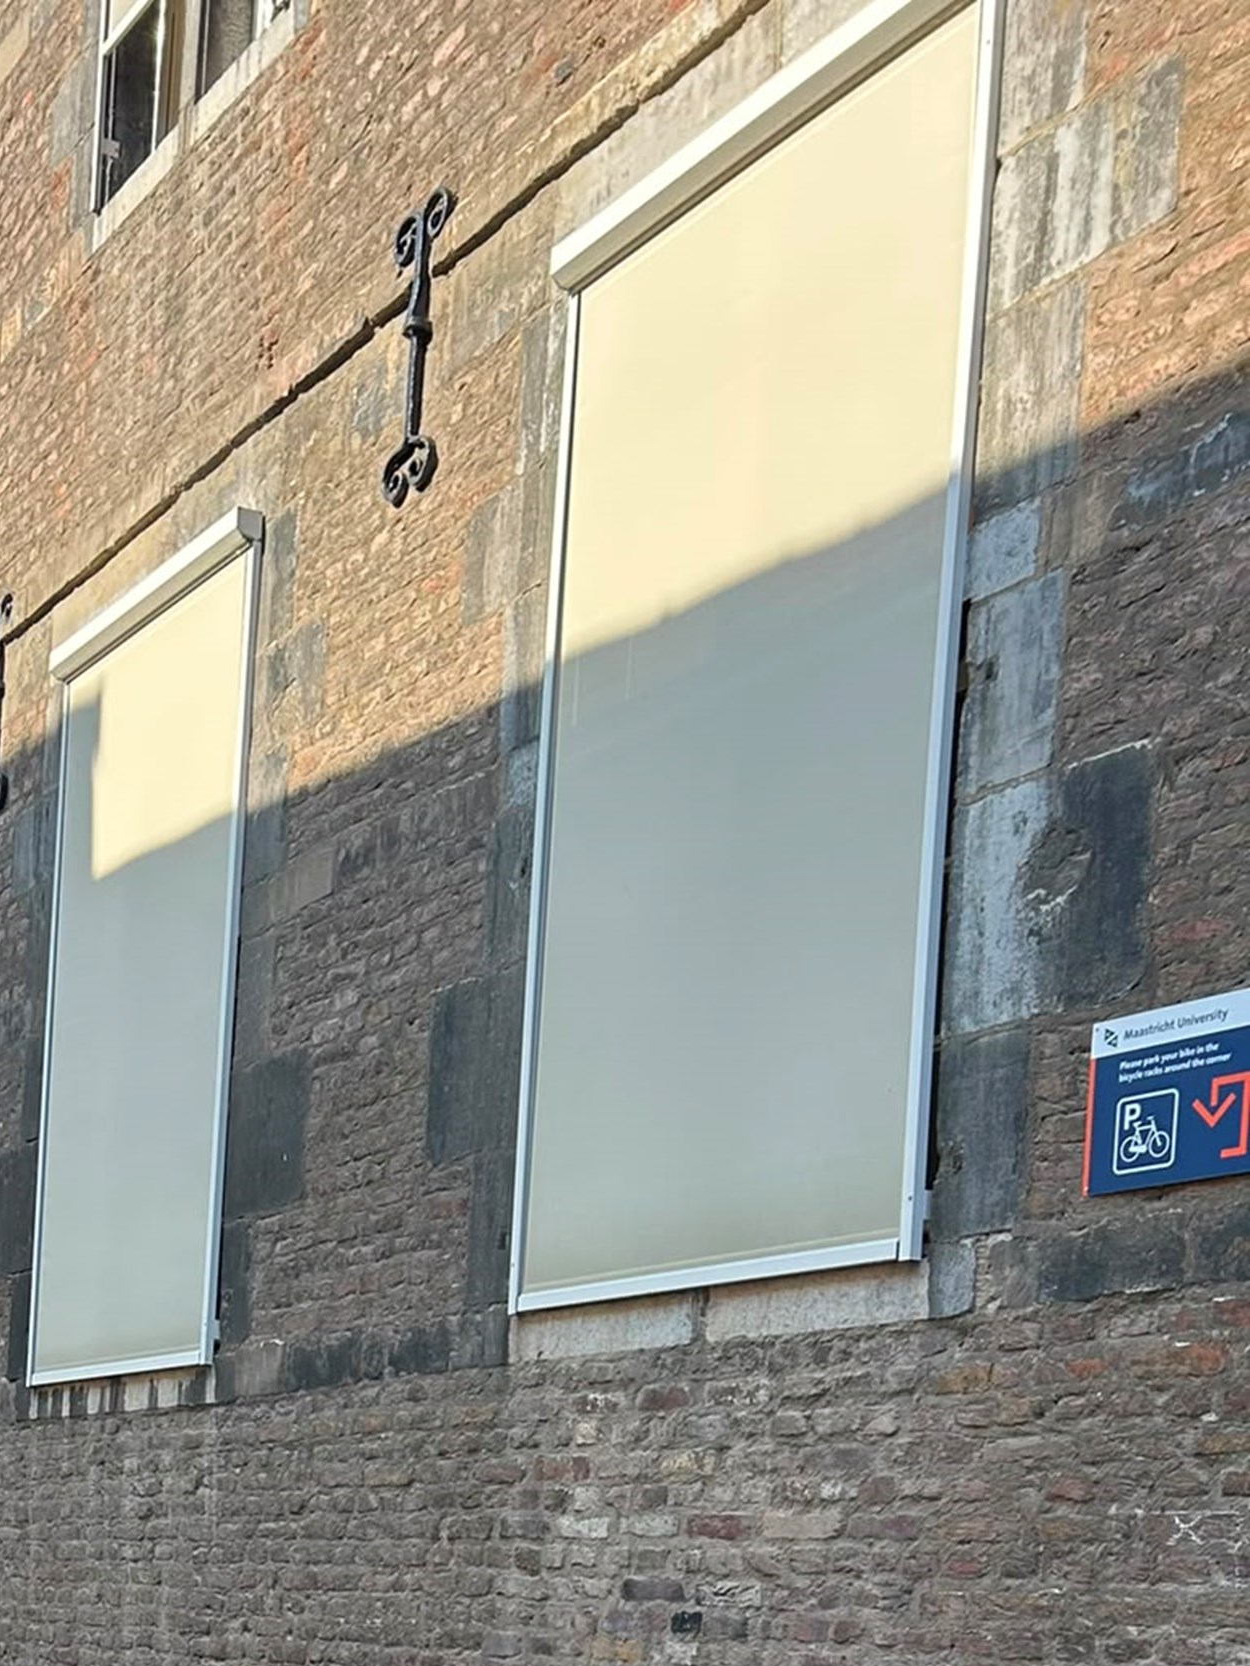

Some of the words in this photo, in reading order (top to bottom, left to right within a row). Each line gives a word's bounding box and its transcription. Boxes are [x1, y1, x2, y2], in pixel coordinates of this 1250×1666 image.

[1123, 1020, 1175, 1040] Maastricht
[1177, 1009, 1228, 1028] University
[1143, 1055, 1159, 1067] park
[1161, 1053, 1178, 1064] your
[1179, 1048, 1195, 1058] bike
[1196, 1045, 1205, 1055] in
[1205, 1042, 1220, 1053] the
[1119, 1071, 1142, 1083] bicycle
[1165, 1060, 1190, 1073] around
[1191, 1059, 1205, 1069] the
[1124, 1103, 1141, 1131] P
